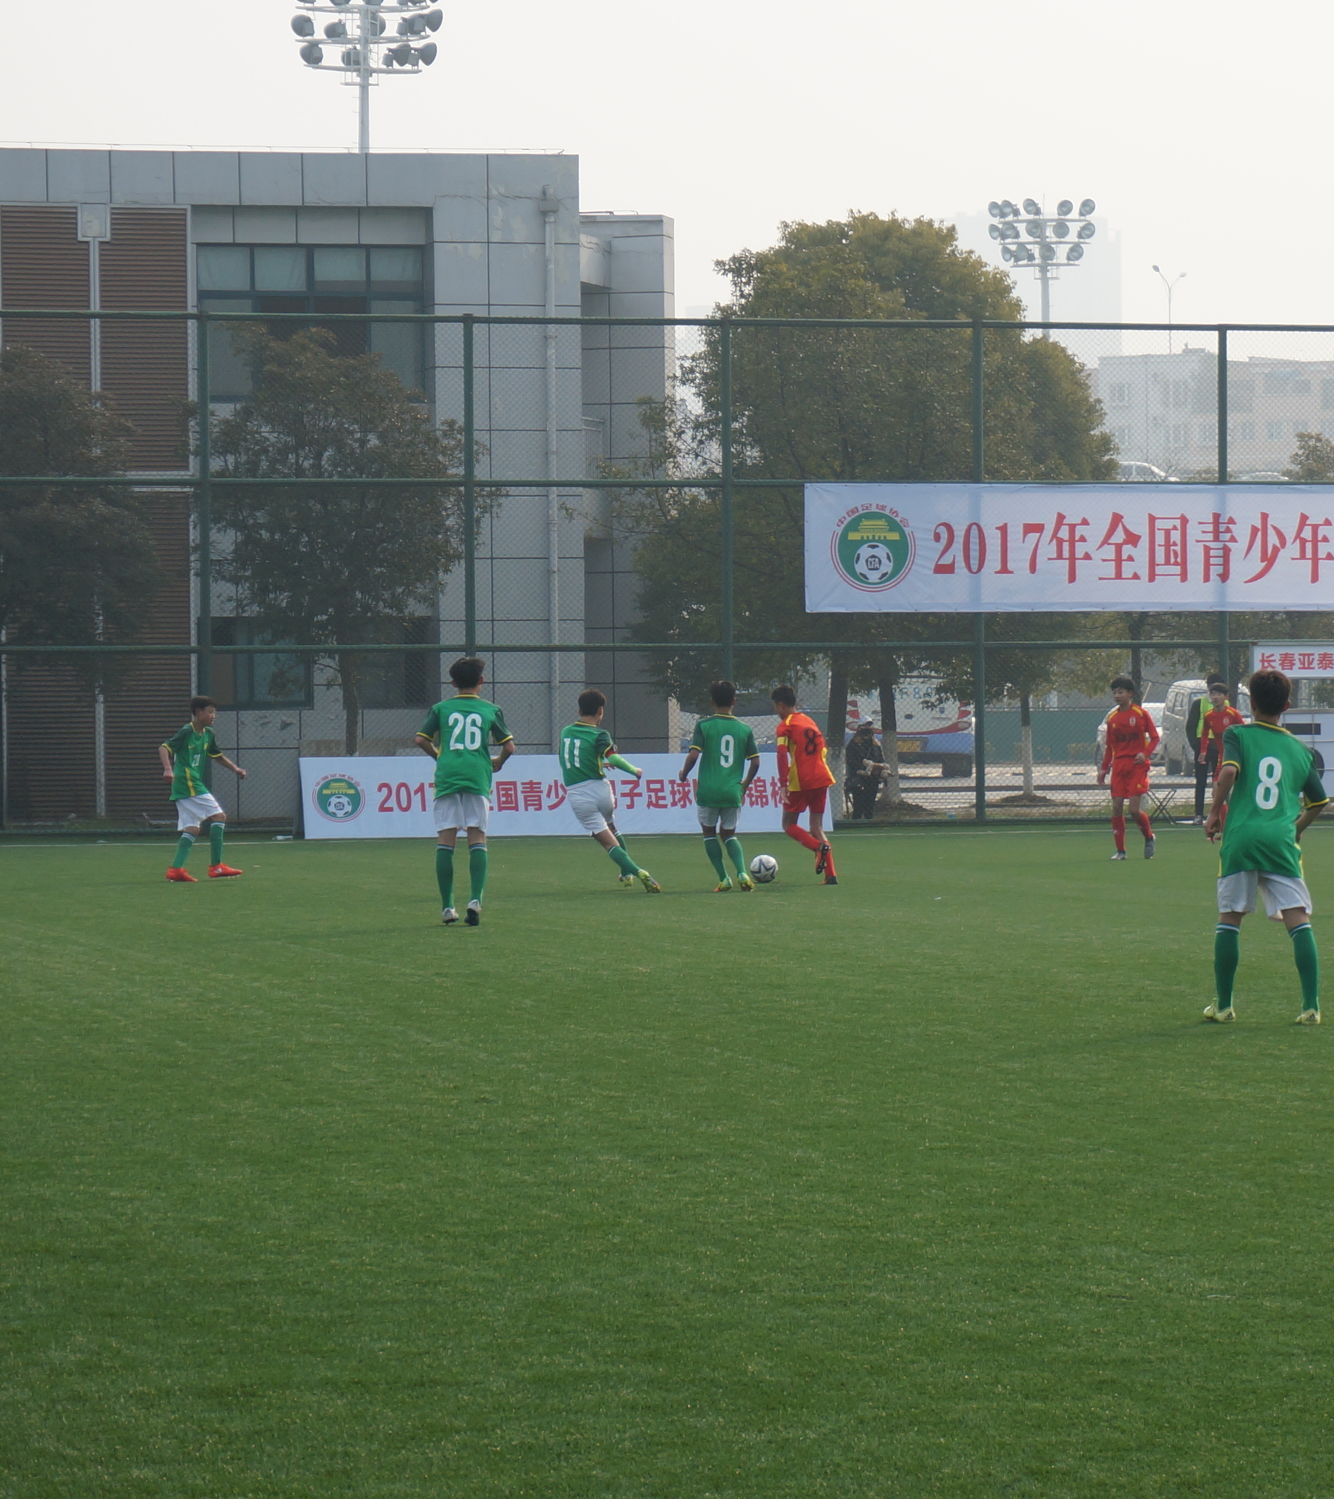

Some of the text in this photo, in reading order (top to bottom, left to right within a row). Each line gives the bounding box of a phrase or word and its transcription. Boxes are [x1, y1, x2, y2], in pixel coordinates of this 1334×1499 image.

[1259, 652, 1334, 672] 长春亚泰
[448, 712, 482, 751] 26
[804, 728, 817, 755] 8
[562, 737, 581, 769] 11
[719, 734, 734, 768] 9
[1255, 756, 1282, 810] 8
